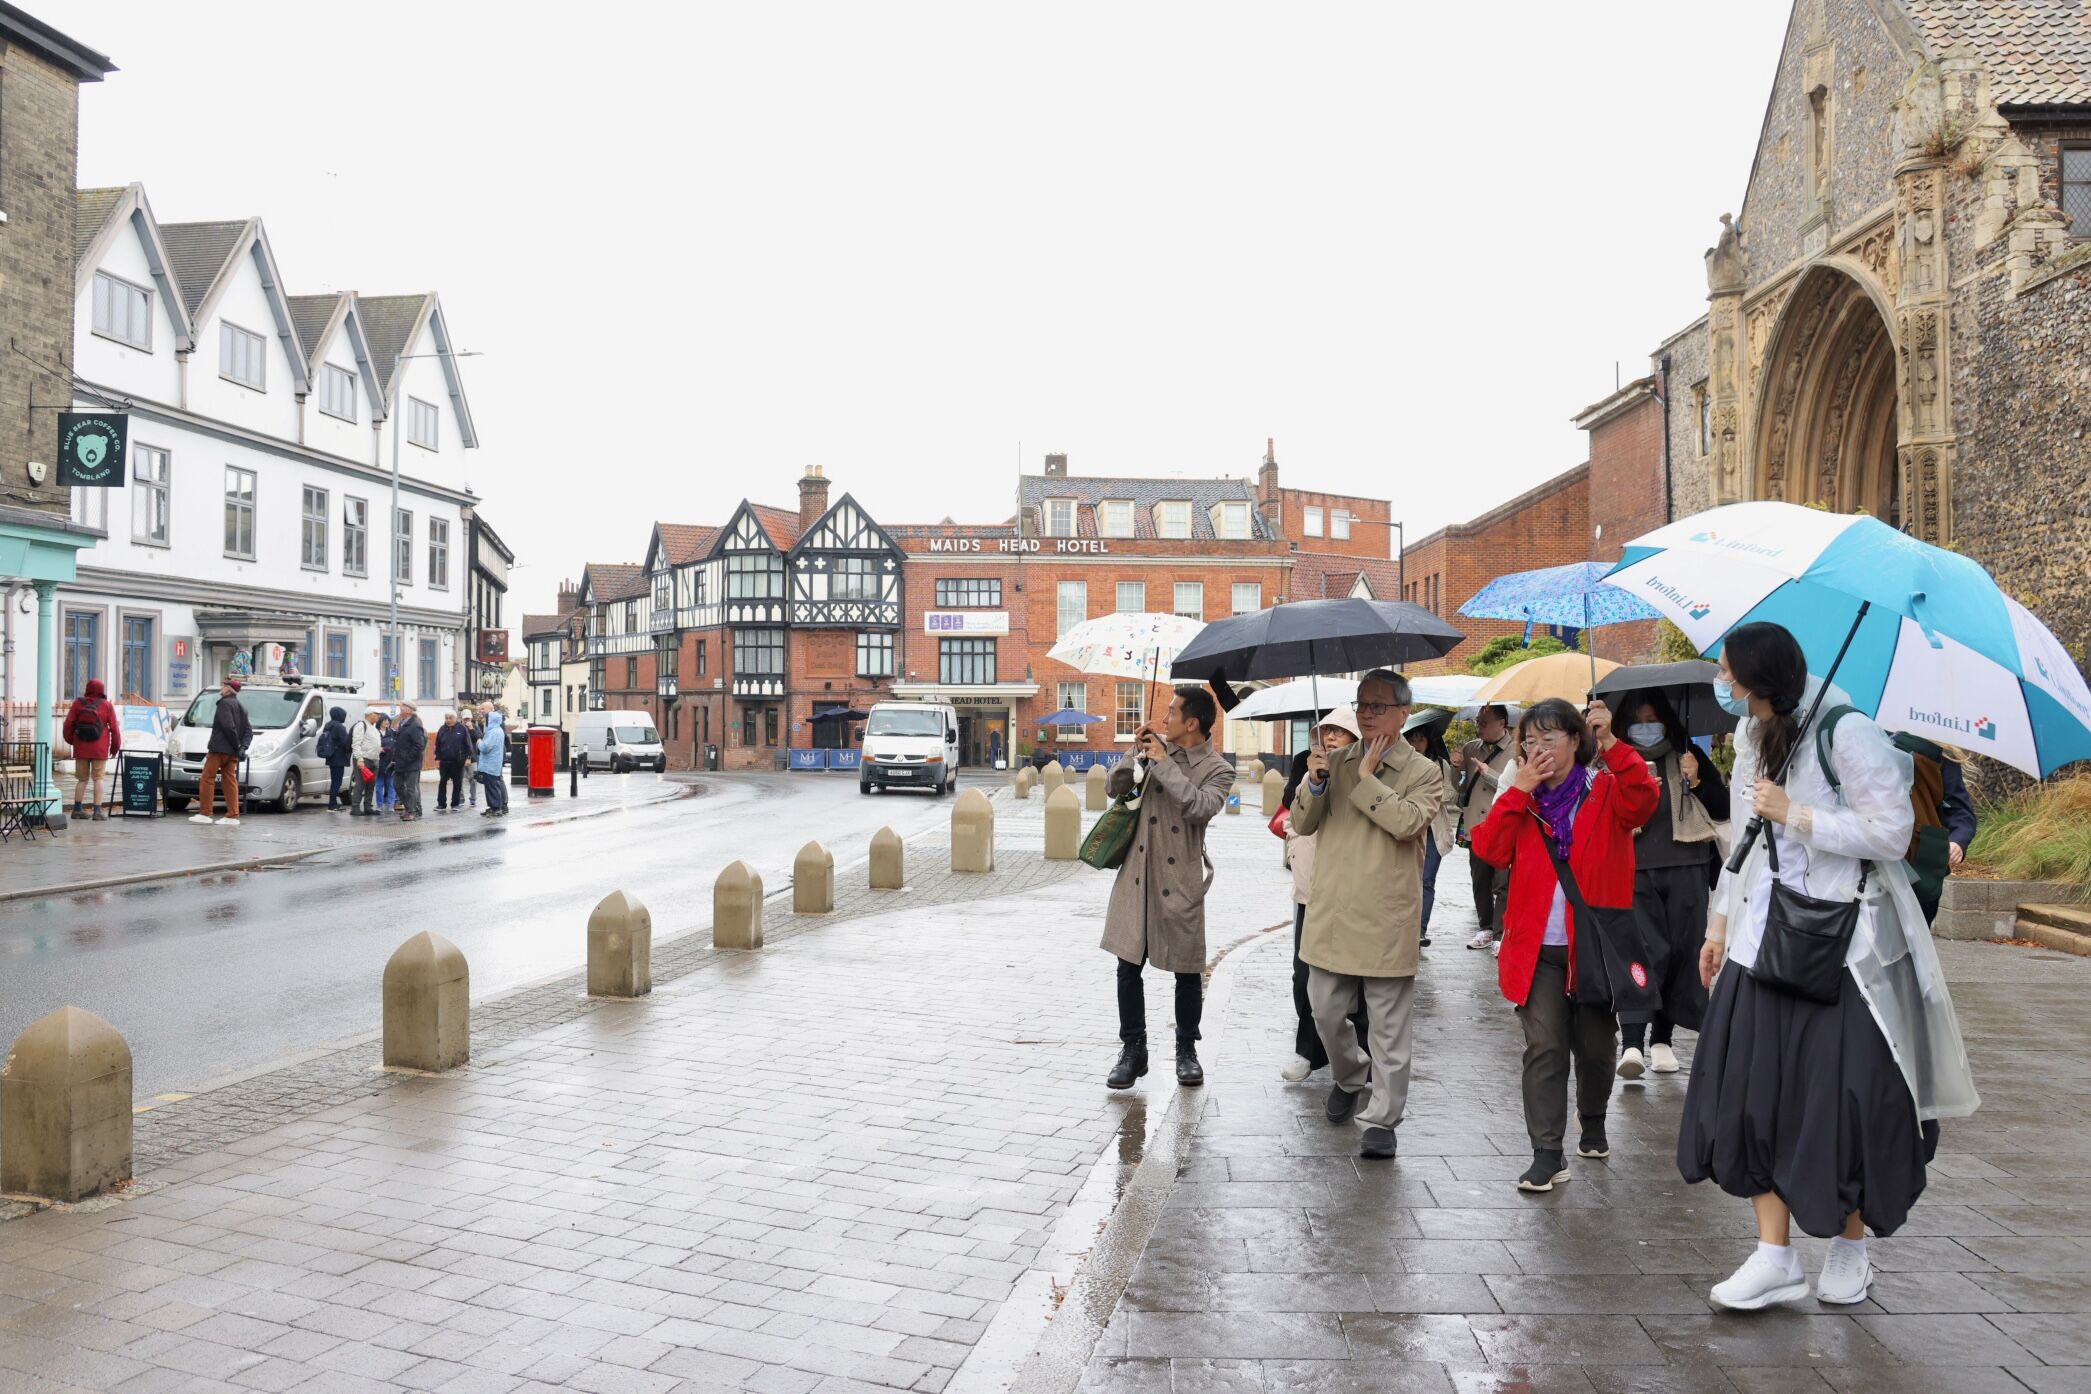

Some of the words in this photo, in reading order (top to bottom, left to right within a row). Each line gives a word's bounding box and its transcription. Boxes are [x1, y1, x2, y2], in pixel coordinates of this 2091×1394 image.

[64, 431, 74, 450] BLUE
[73, 420, 91, 431] BEAR
[94, 420, 117, 438] COFFEE
[72, 468, 110, 480] TOMBLAND
[930, 539, 980, 551] MAIDS
[1000, 539, 1040, 551] HEAD
[1057, 540, 1108, 552] HOTEL
